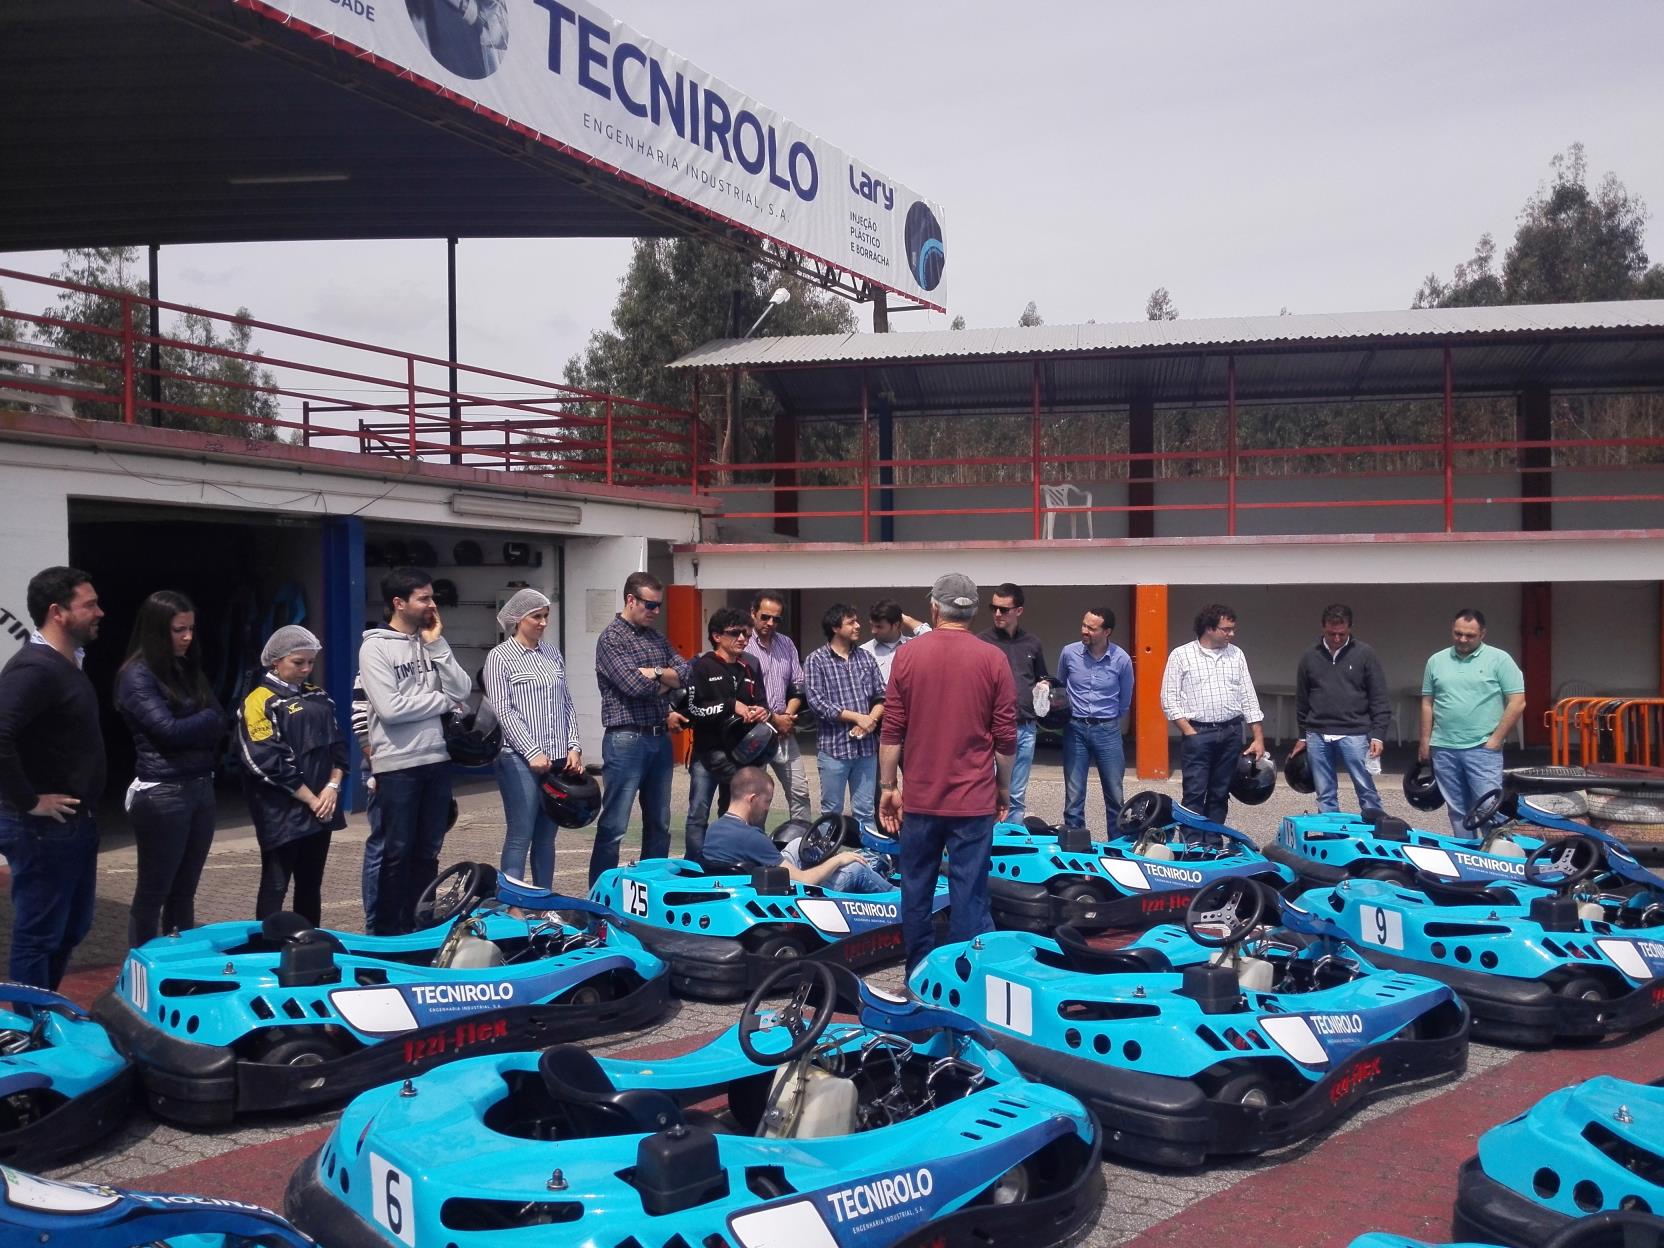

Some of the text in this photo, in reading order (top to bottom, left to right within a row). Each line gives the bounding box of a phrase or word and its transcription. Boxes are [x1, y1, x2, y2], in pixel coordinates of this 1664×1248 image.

[330, 0, 375, 22] ADE
[533, 0, 819, 201] TECNIROLO
[583, 112, 679, 171] ENGENHARIA
[850, 241, 890, 267] E BORRACHA
[1143, 863, 1202, 883] TECNIROLO
[1454, 852, 1525, 876] TECNIROLO
[630, 880, 648, 917] 25
[842, 901, 897, 918] TECNIROLO
[1375, 907, 1387, 945] 9
[412, 982, 514, 1005] TECNIROLO
[1310, 1014, 1362, 1034] TECNIROLO
[386, 1169, 402, 1235] 6
[827, 1168, 933, 1222] TECNIROLO
